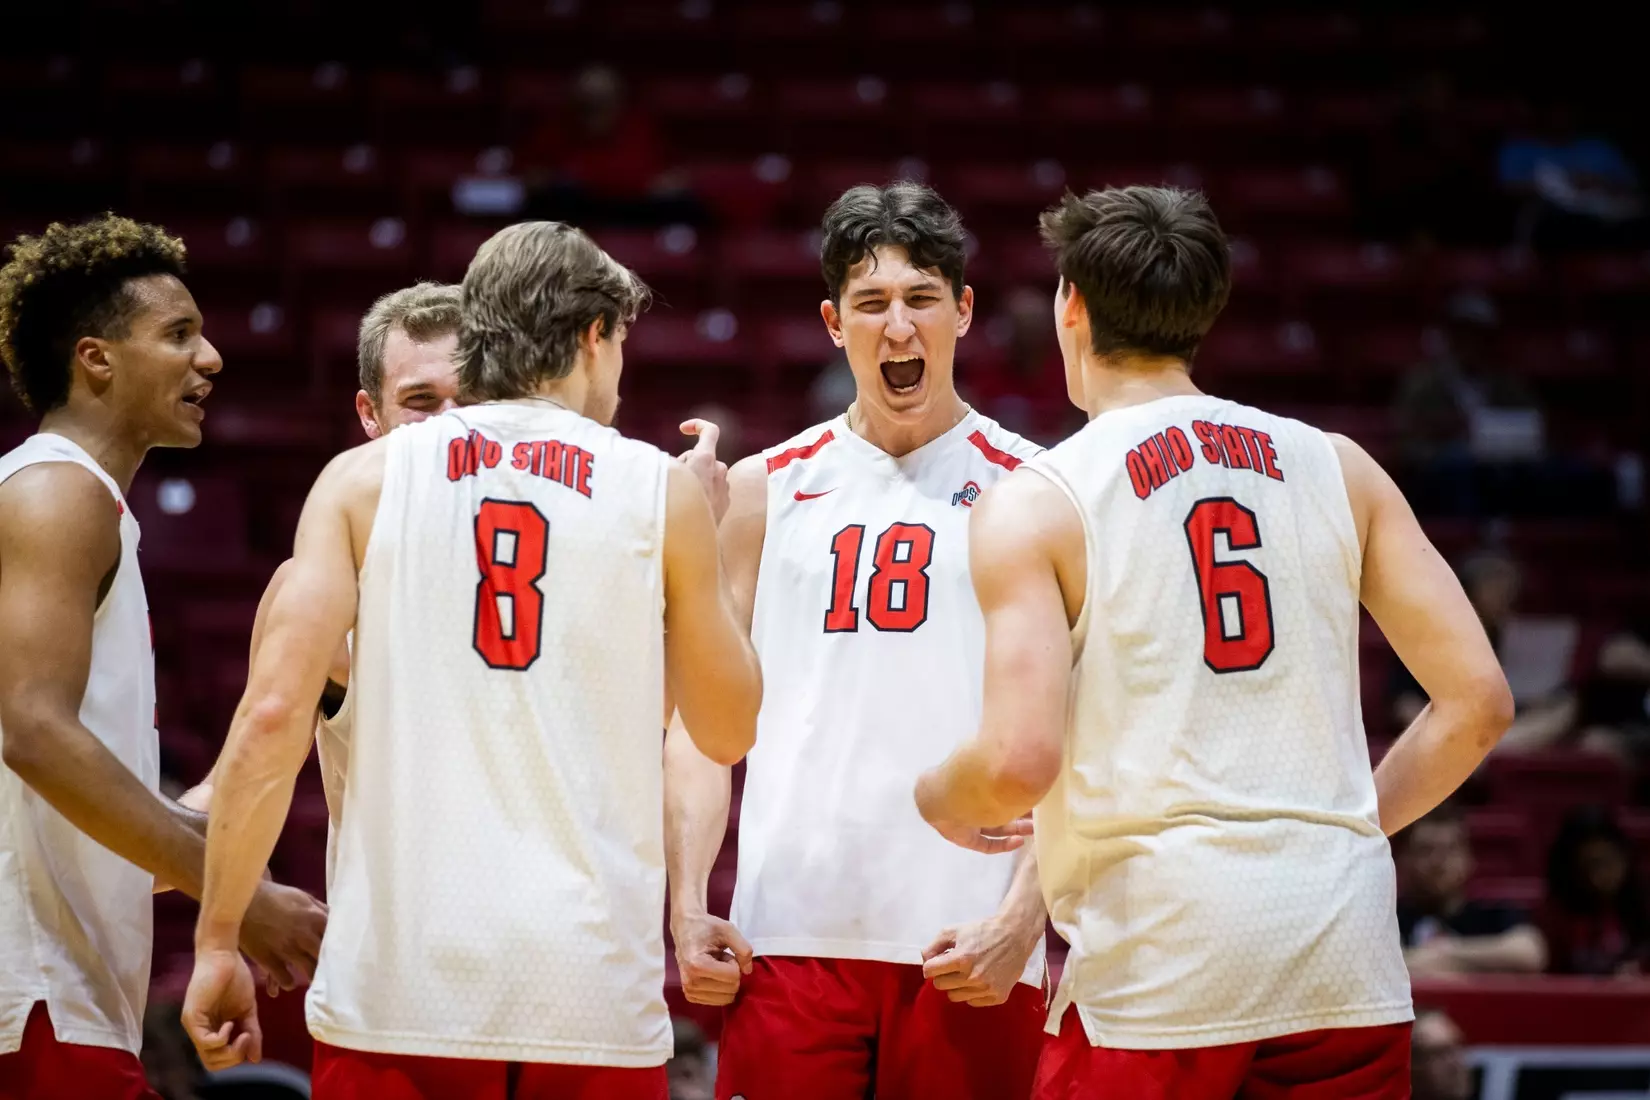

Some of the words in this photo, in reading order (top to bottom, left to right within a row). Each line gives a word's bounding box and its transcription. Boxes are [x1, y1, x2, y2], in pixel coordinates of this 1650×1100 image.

[511, 440, 594, 499] STATE
[1126, 426, 1194, 500] OHIO
[1192, 420, 1285, 482] STATE
[472, 497, 550, 671] 8
[824, 522, 936, 633] 18
[1183, 497, 1275, 674] 6
